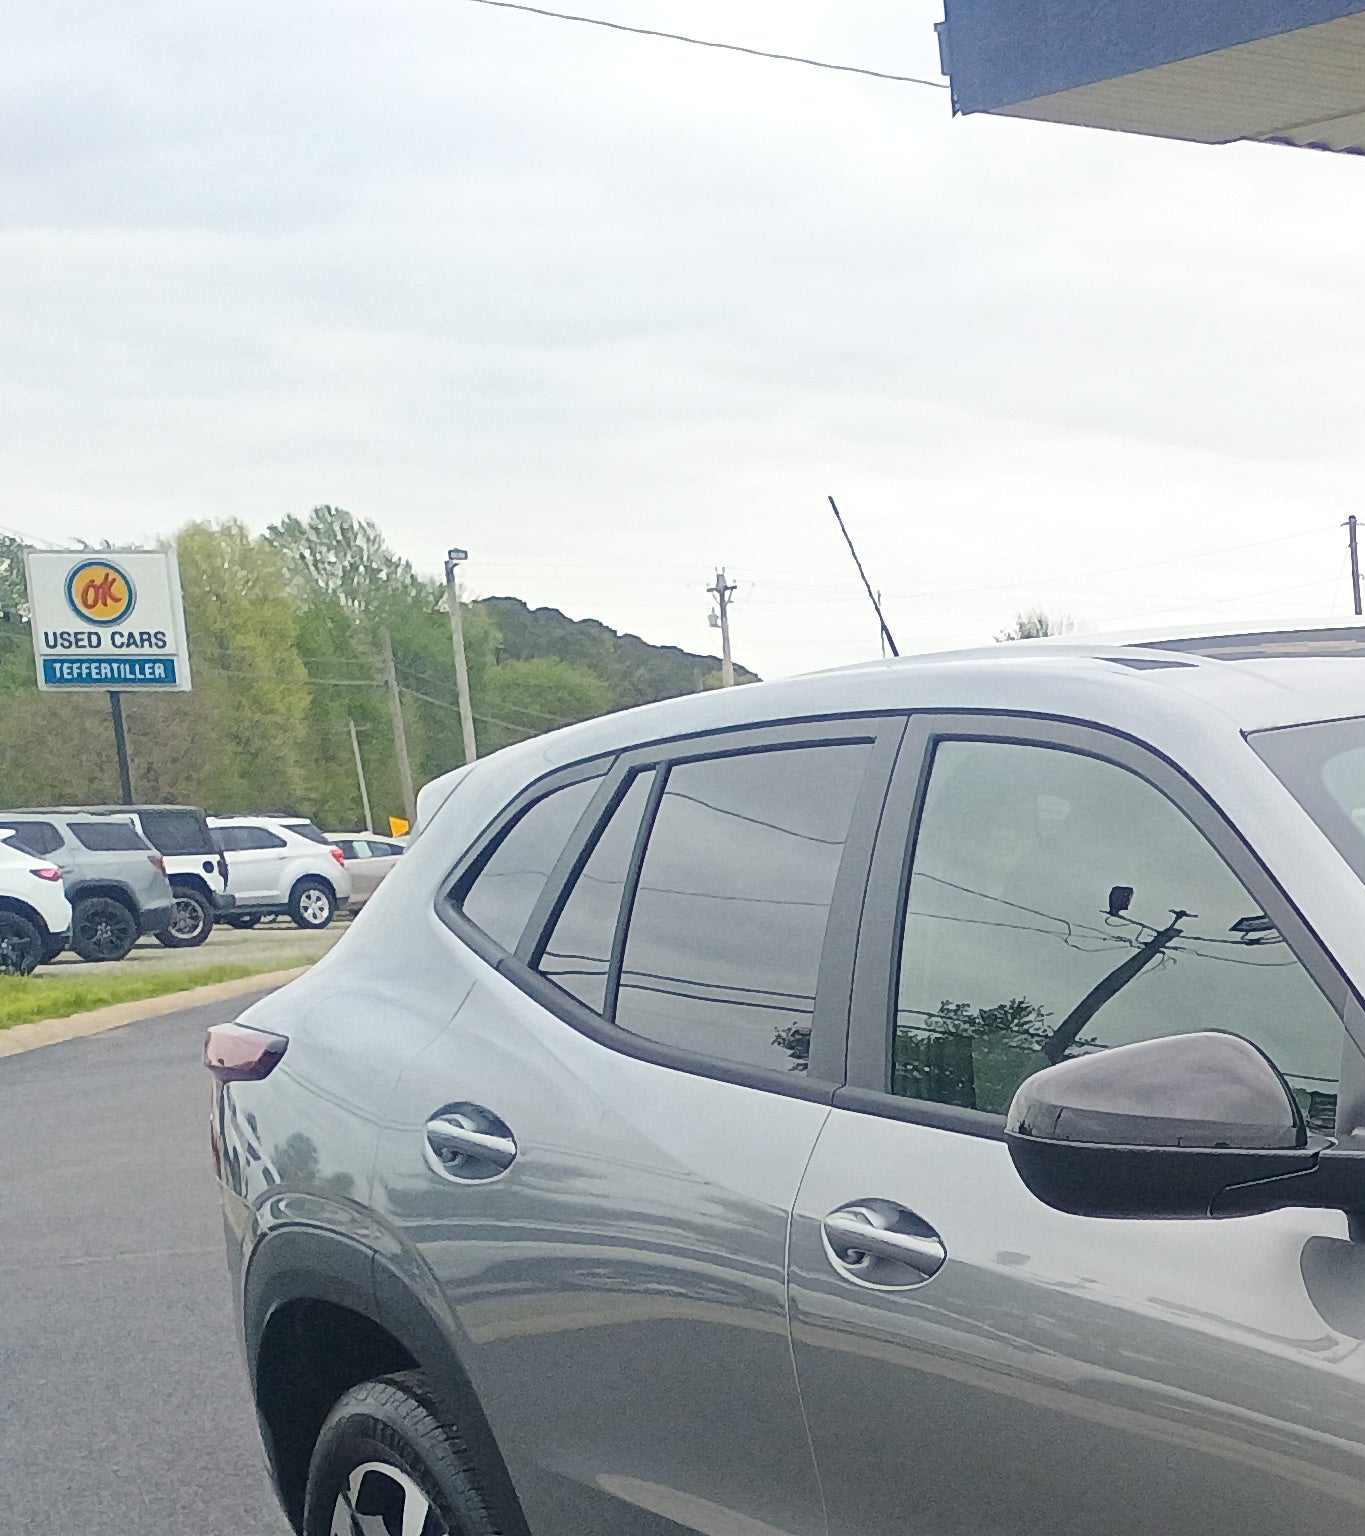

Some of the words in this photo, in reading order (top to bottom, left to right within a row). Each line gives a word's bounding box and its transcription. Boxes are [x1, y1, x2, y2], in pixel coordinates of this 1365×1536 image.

[81, 572, 122, 609] OK
[44, 631, 101, 649] USED
[111, 631, 167, 649] CARS
[53, 662, 166, 679] TEFFERTILLER
